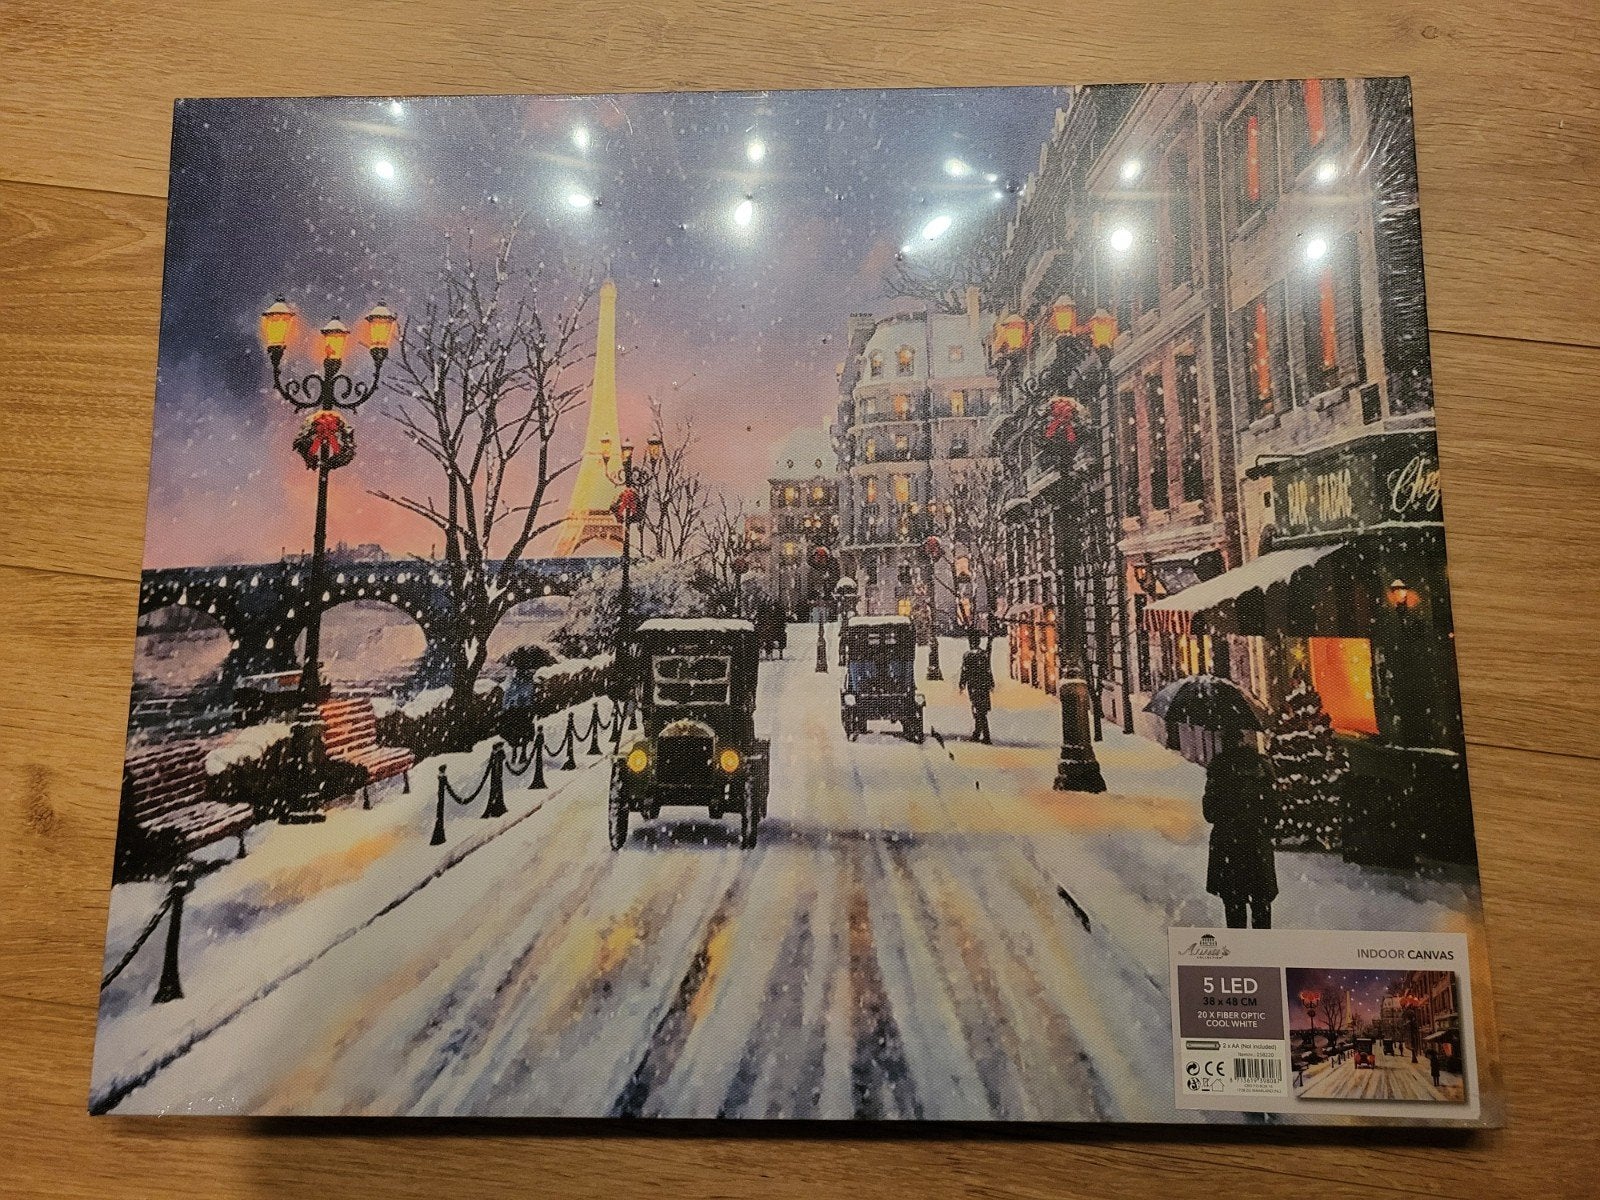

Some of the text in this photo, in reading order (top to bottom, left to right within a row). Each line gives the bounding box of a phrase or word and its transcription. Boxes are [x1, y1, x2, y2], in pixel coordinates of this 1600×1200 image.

[1287, 479, 1309, 526] BAR
[1357, 948, 1454, 961] INDOOR CANVAS
[1203, 977, 1258, 994] 5 LED
[1203, 997, 1215, 1006] 38
[1226, 997, 1238, 1007] 48
[1240, 997, 1257, 1007] CM
[1197, 1010, 1266, 1020] 20 X FIBER OPTIC
[1206, 1019, 1258, 1028] COOL WHITE
